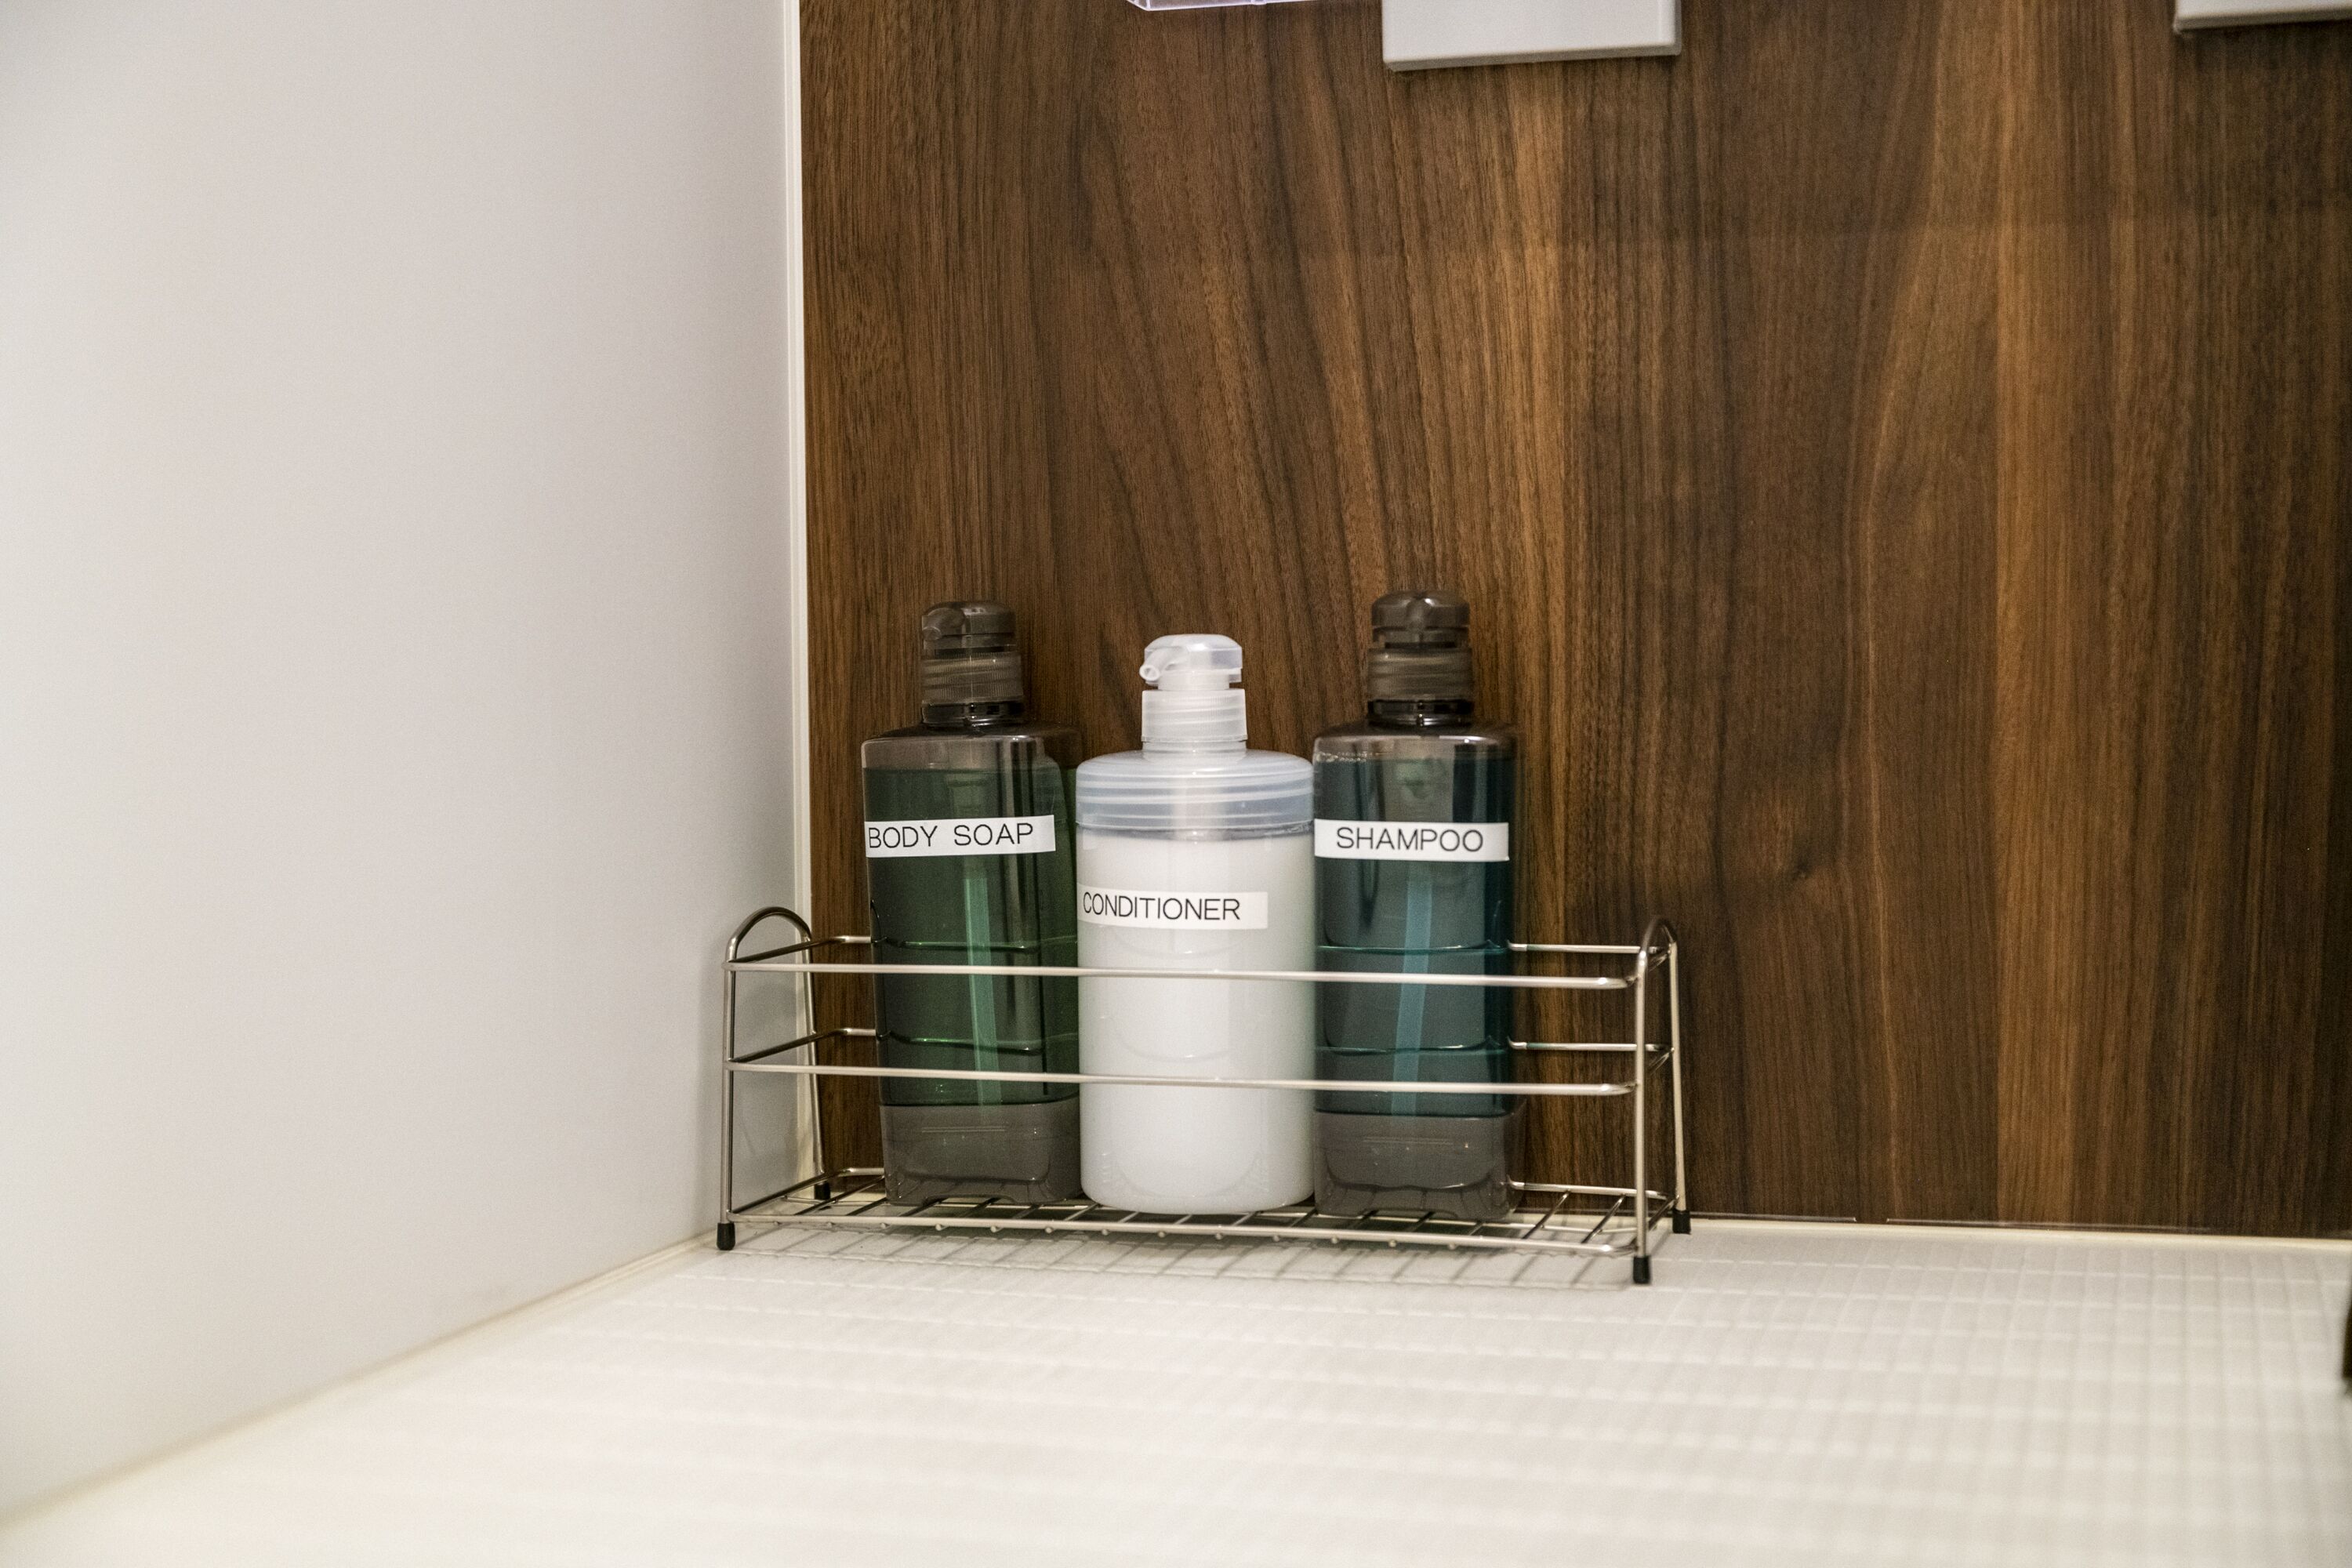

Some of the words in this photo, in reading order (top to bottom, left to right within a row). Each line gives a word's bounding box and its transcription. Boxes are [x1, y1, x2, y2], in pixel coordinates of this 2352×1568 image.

[868, 825, 938, 848] BODY
[953, 822, 1033, 846] SOAP
[1336, 827, 1484, 851] SHAMPOO
[1083, 892, 1241, 920] CONDITIONER
